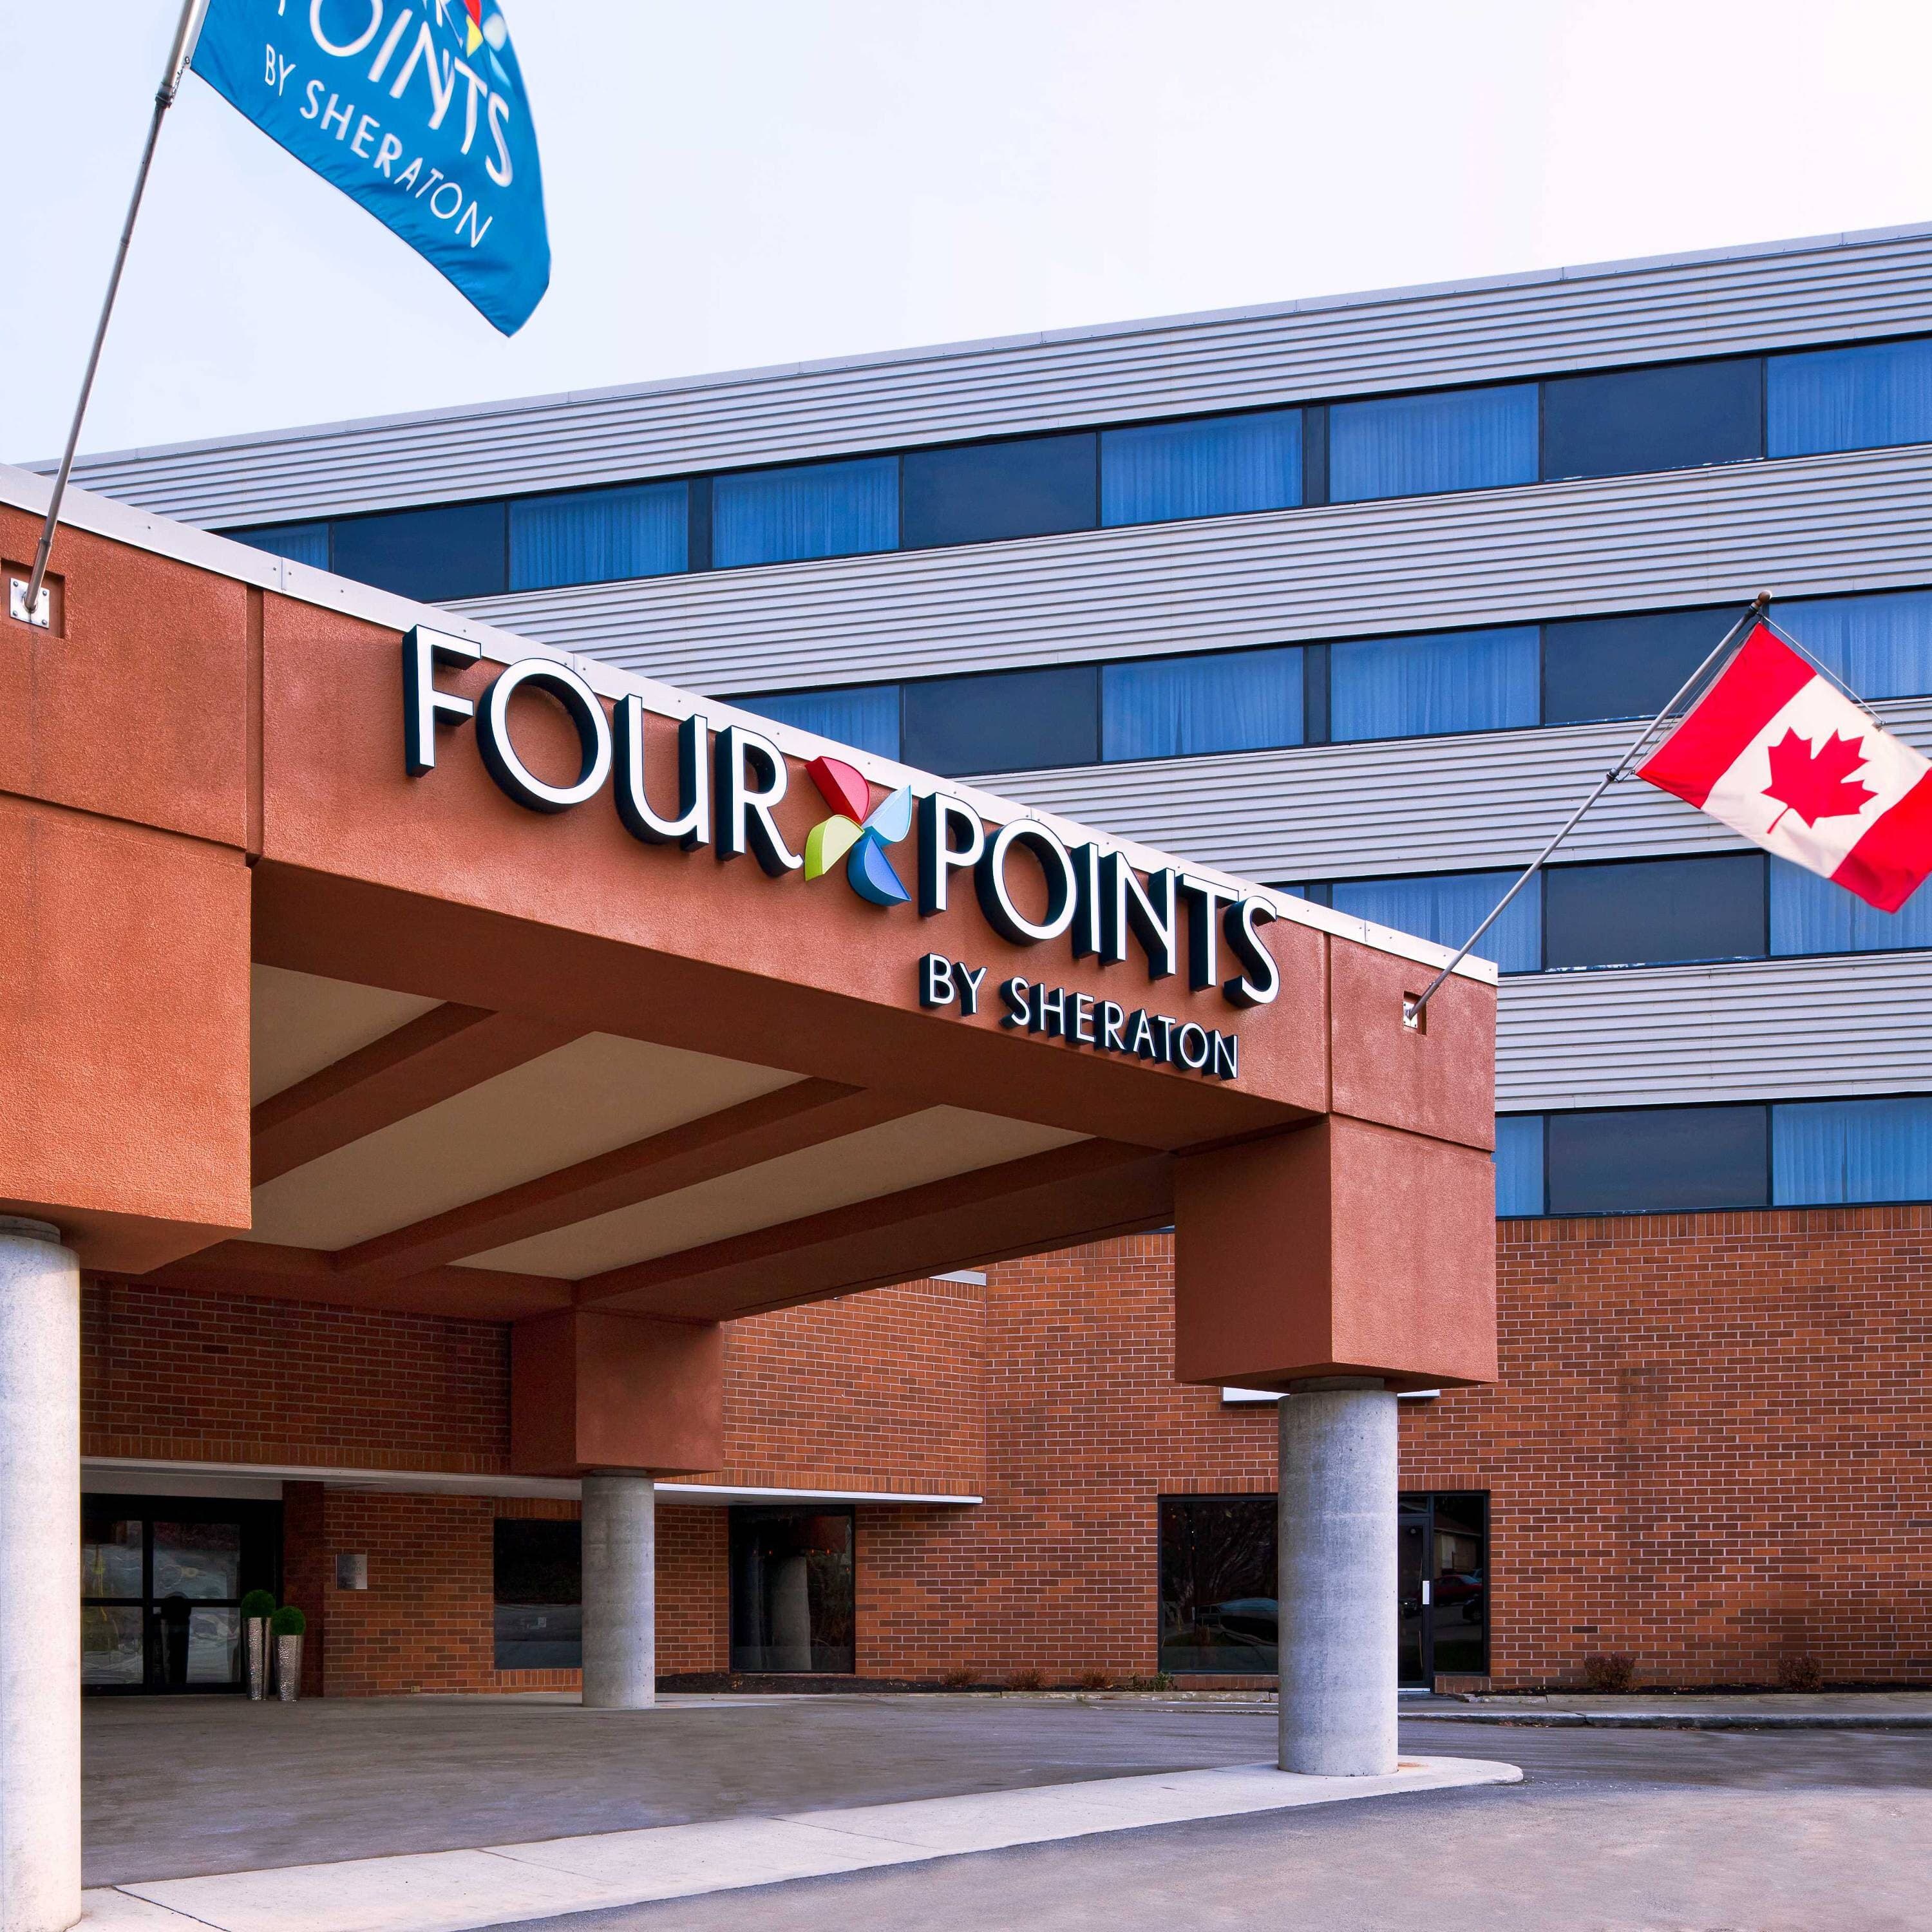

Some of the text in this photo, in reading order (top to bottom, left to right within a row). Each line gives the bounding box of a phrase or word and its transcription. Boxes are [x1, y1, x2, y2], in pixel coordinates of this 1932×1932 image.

[265, 44, 493, 248] BY SHERATON
[278, 0, 513, 187] OINTS
[402, 623, 1280, 1006] FOUR POINTS
[920, 952, 1238, 1080] BY SHERATON
